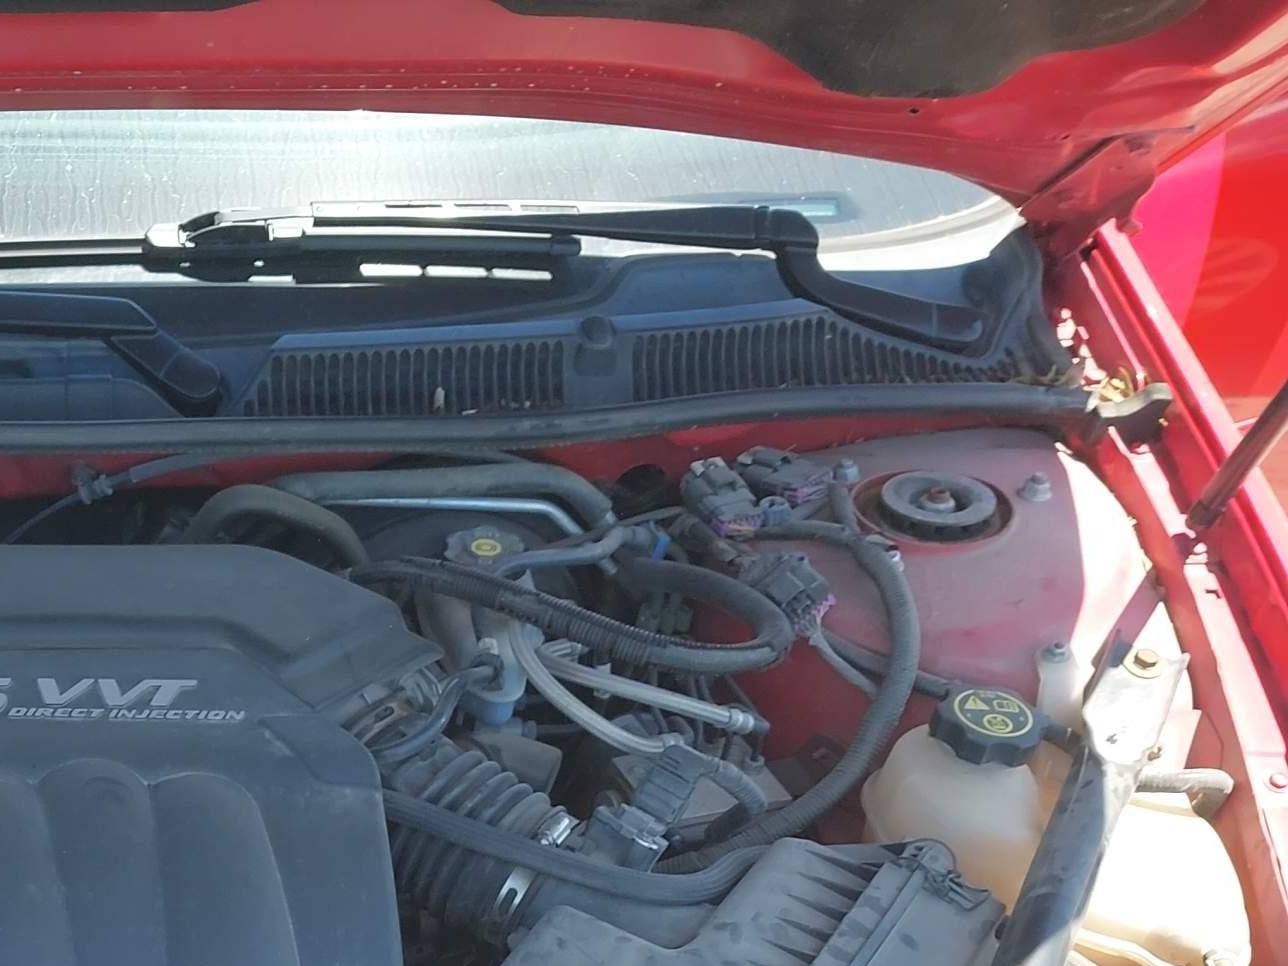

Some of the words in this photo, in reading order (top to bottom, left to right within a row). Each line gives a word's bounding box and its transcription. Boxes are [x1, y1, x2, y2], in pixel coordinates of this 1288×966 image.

[37, 677, 198, 707] VVT
[8, 707, 104, 718] DIRECT
[109, 708, 245, 720] INJECTION
